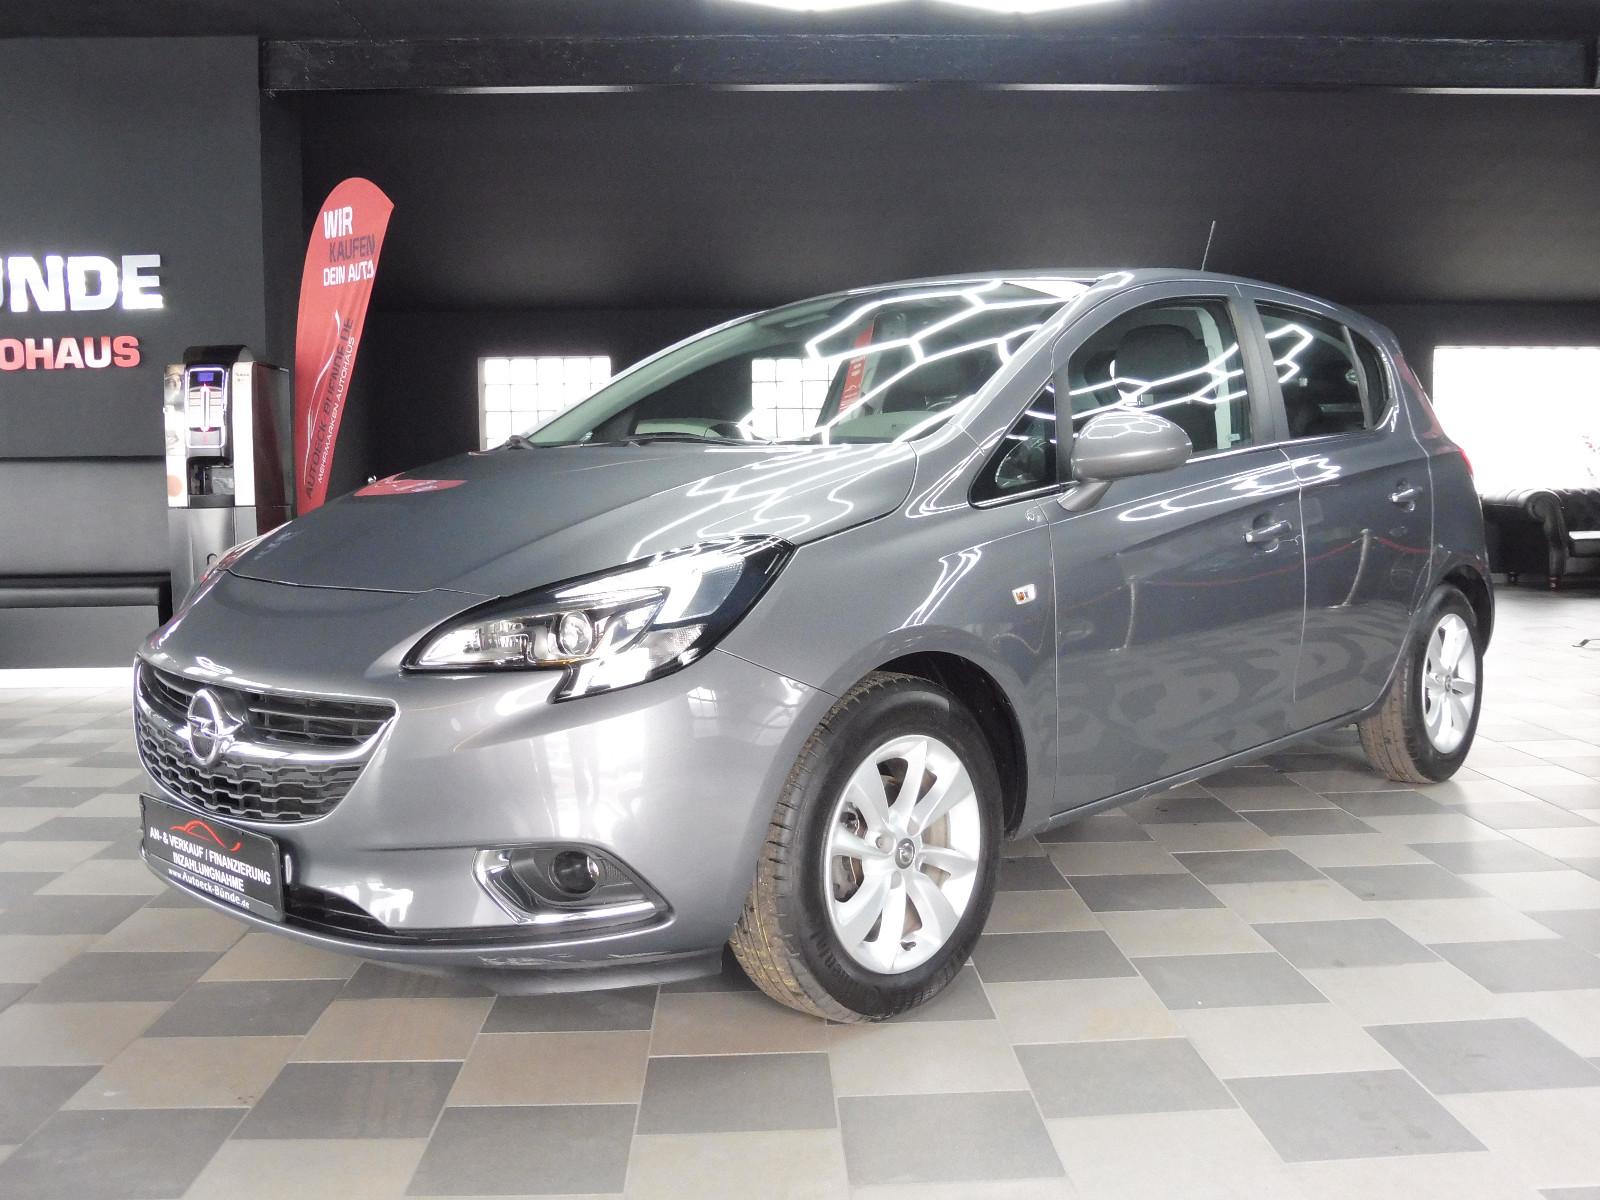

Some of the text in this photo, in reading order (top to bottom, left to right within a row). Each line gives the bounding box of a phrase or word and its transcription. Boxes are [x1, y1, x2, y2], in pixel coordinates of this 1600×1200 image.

[323, 206, 353, 239] WIR
[329, 233, 375, 263] KAUFEN
[0, 254, 164, 312] NDE
[323, 265, 345, 287] DEIN
[0, 335, 141, 371] OHAUS
[318, 336, 355, 483] MEHRMARKEN AUTOHAUS
[162, 832, 169, 844] &
[168, 833, 204, 859] VERKAUF
[209, 850, 271, 885] FINANZIERUNG
[172, 852, 245, 892] INZAHLUNGNAHME
[168, 868, 250, 909] www.Autoeck-Bünde.de
